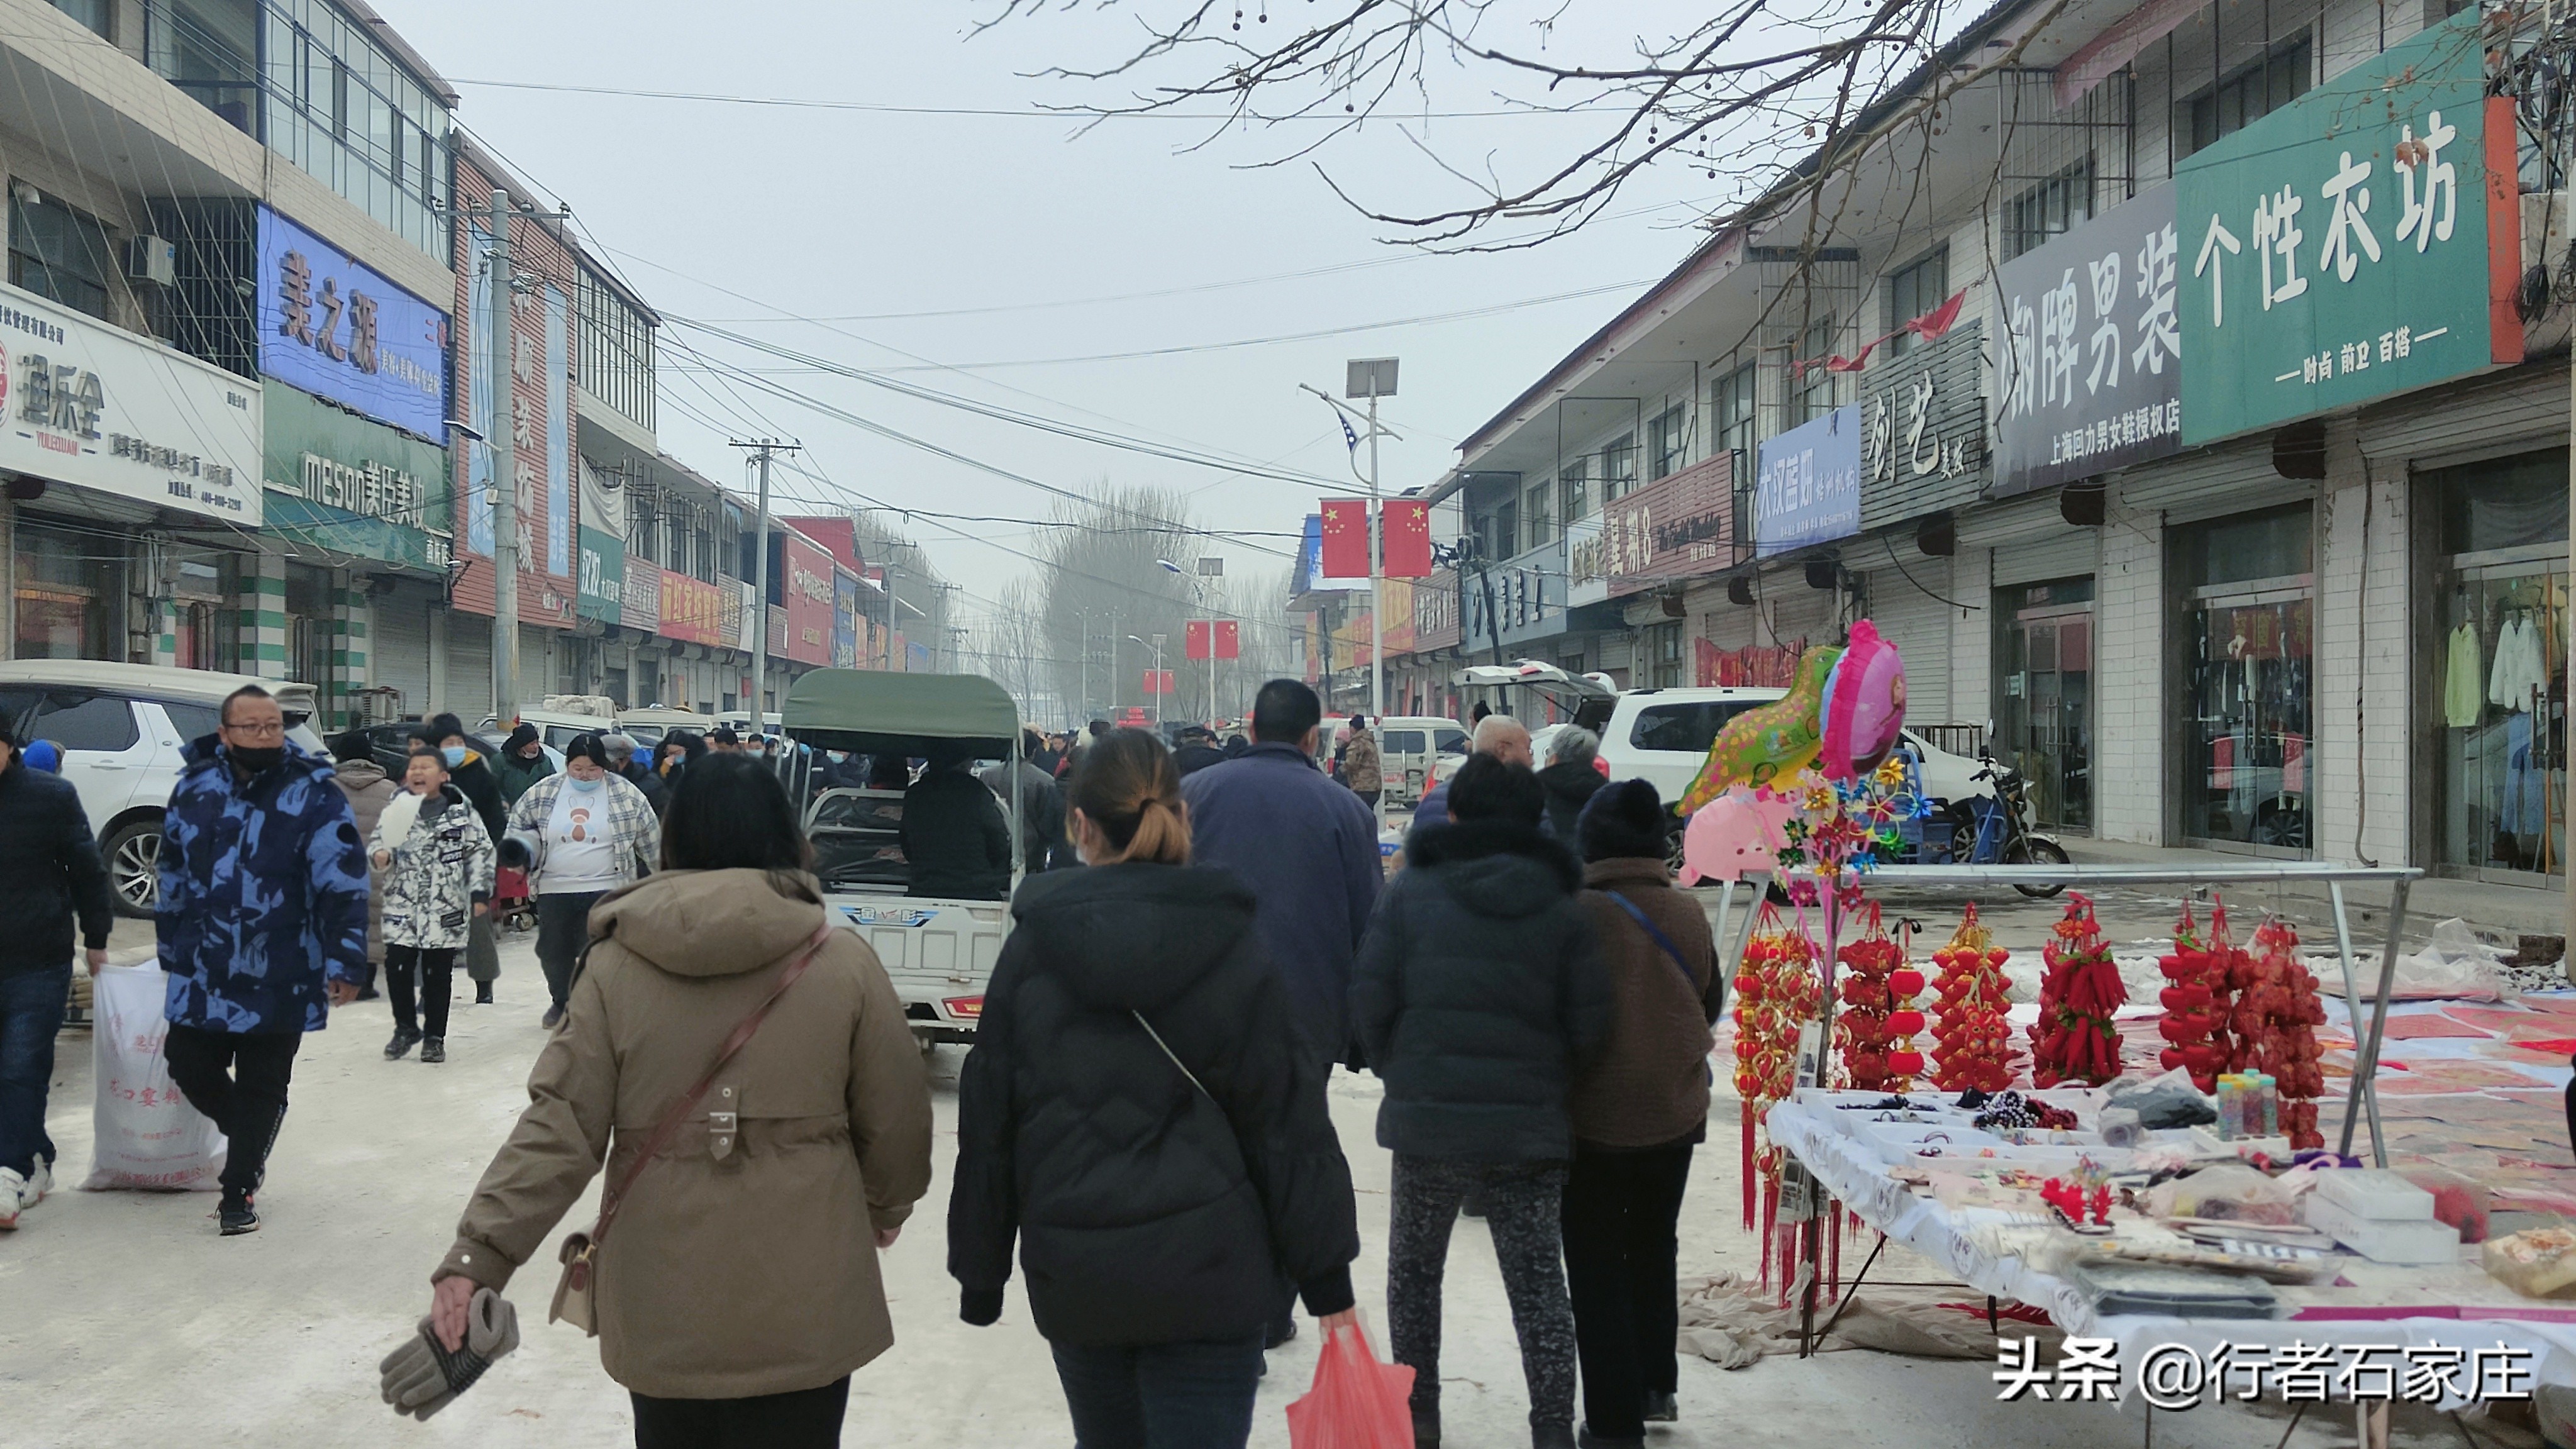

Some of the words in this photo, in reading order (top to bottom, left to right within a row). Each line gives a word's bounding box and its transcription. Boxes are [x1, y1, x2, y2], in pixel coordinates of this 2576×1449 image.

[2194, 109, 2456, 328] 个性衣坊
[278, 249, 379, 375] 美之源
[2001, 222, 2181, 421] 潮牌男装
[2303, 350, 2333, 385] 时尚
[2340, 340, 2371, 375] 前卫
[2379, 325, 2412, 363] 百搭
[36, 430, 79, 457] YULEQUAN
[1866, 369, 1940, 484] 创艺
[2050, 397, 2180, 466] 上海回力男女鞋授权店
[1610, 504, 1653, 577] 星期8
